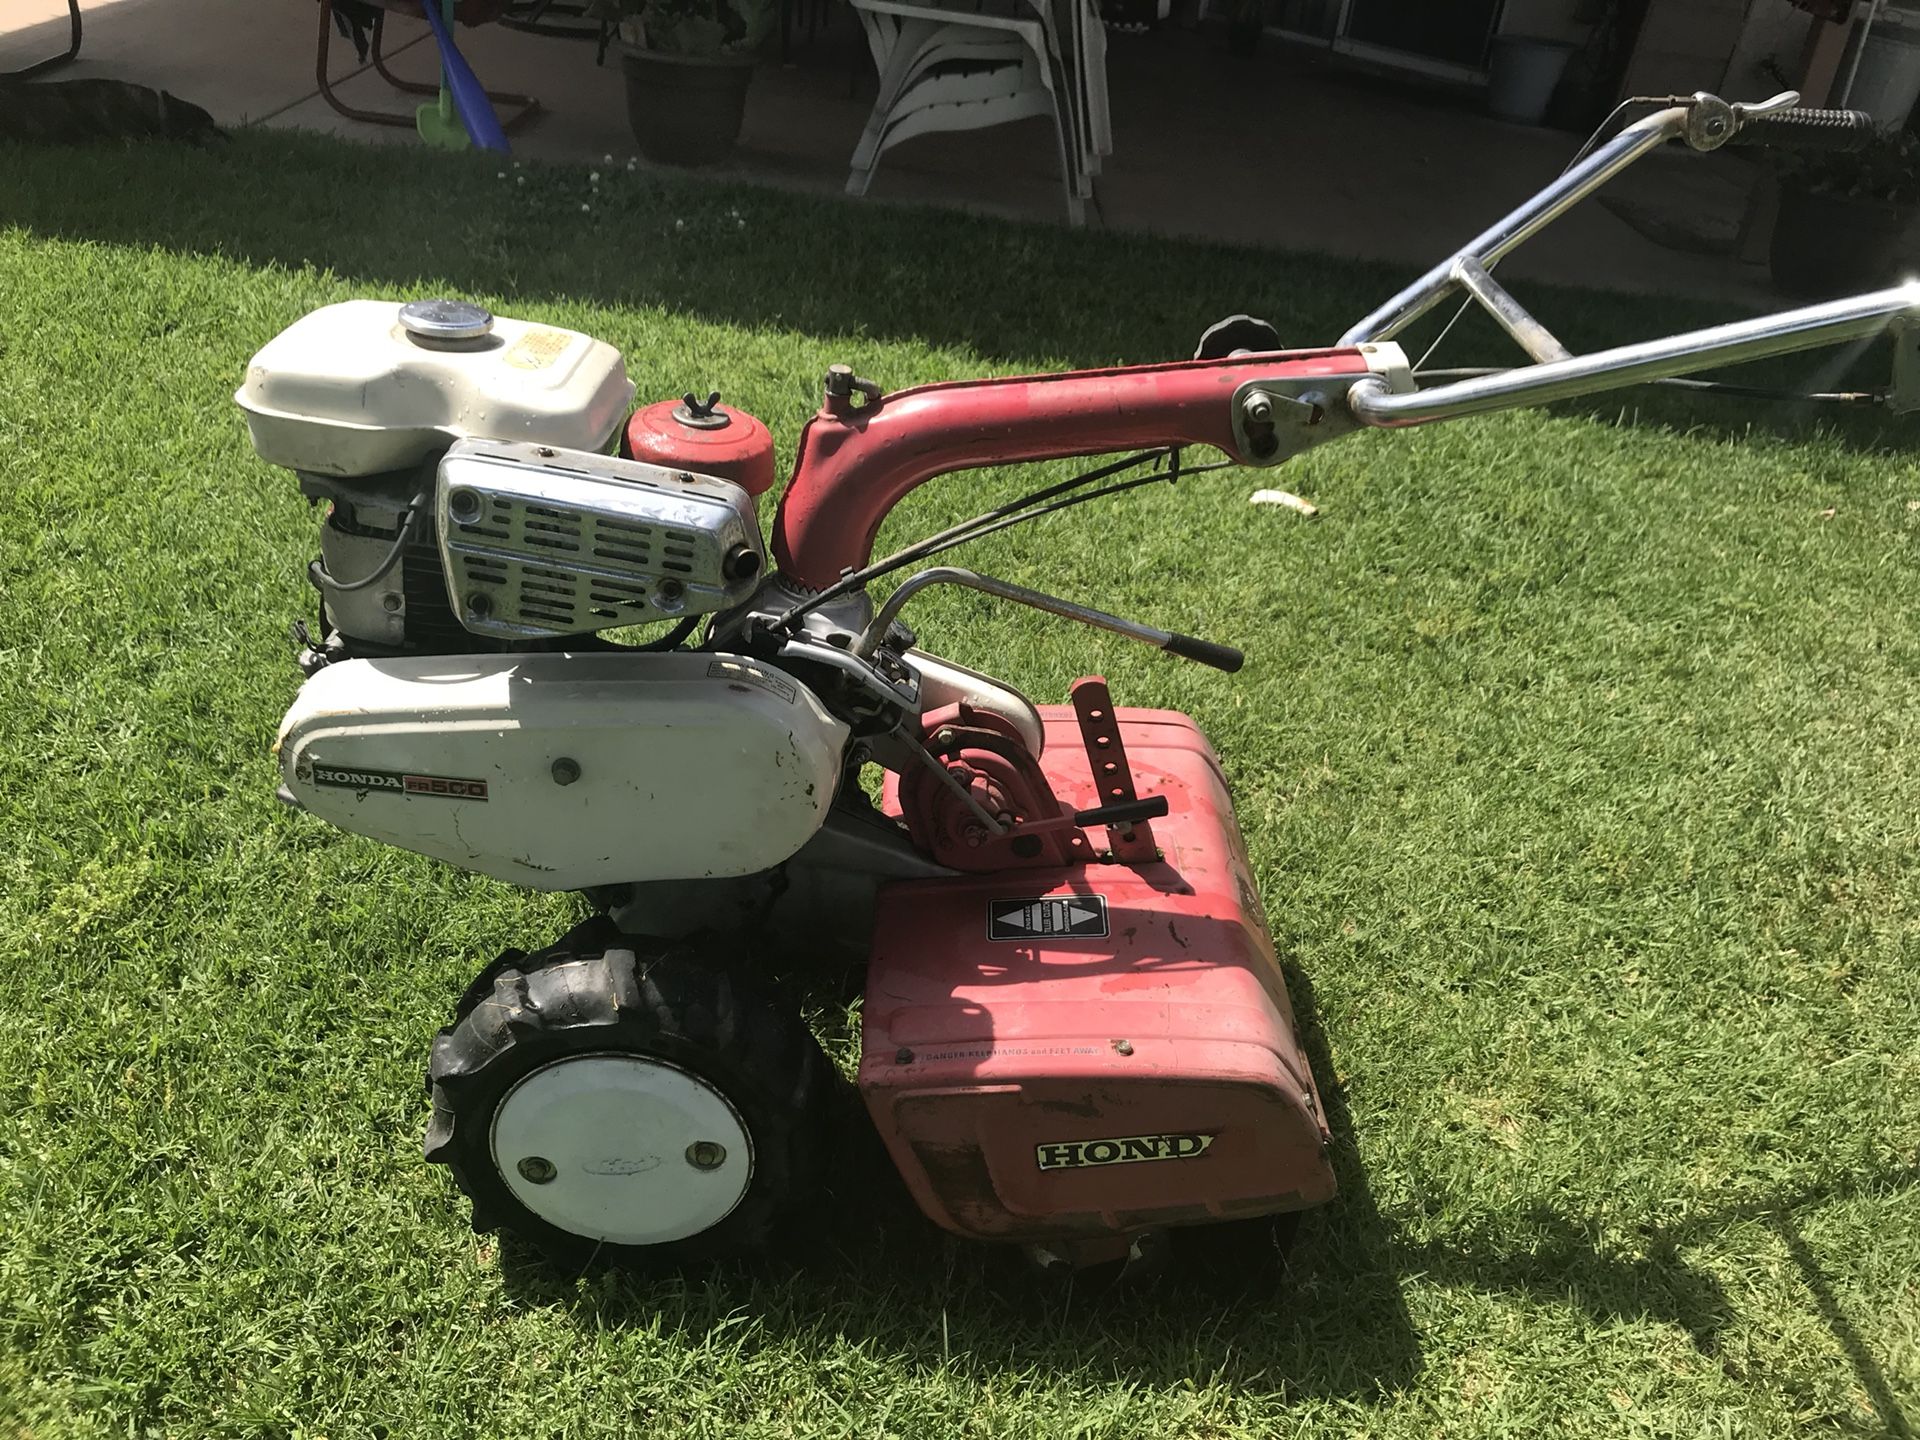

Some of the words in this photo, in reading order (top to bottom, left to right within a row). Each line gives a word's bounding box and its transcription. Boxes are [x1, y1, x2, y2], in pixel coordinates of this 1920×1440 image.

[315, 769, 402, 788] HONDA
[926, 1051, 965, 1061] DANGER
[968, 1050, 992, 1058] KEEP
[1031, 1047, 1047, 1055] and
[1049, 1047, 1071, 1056] FEET
[1073, 1047, 1099, 1055] AWAY
